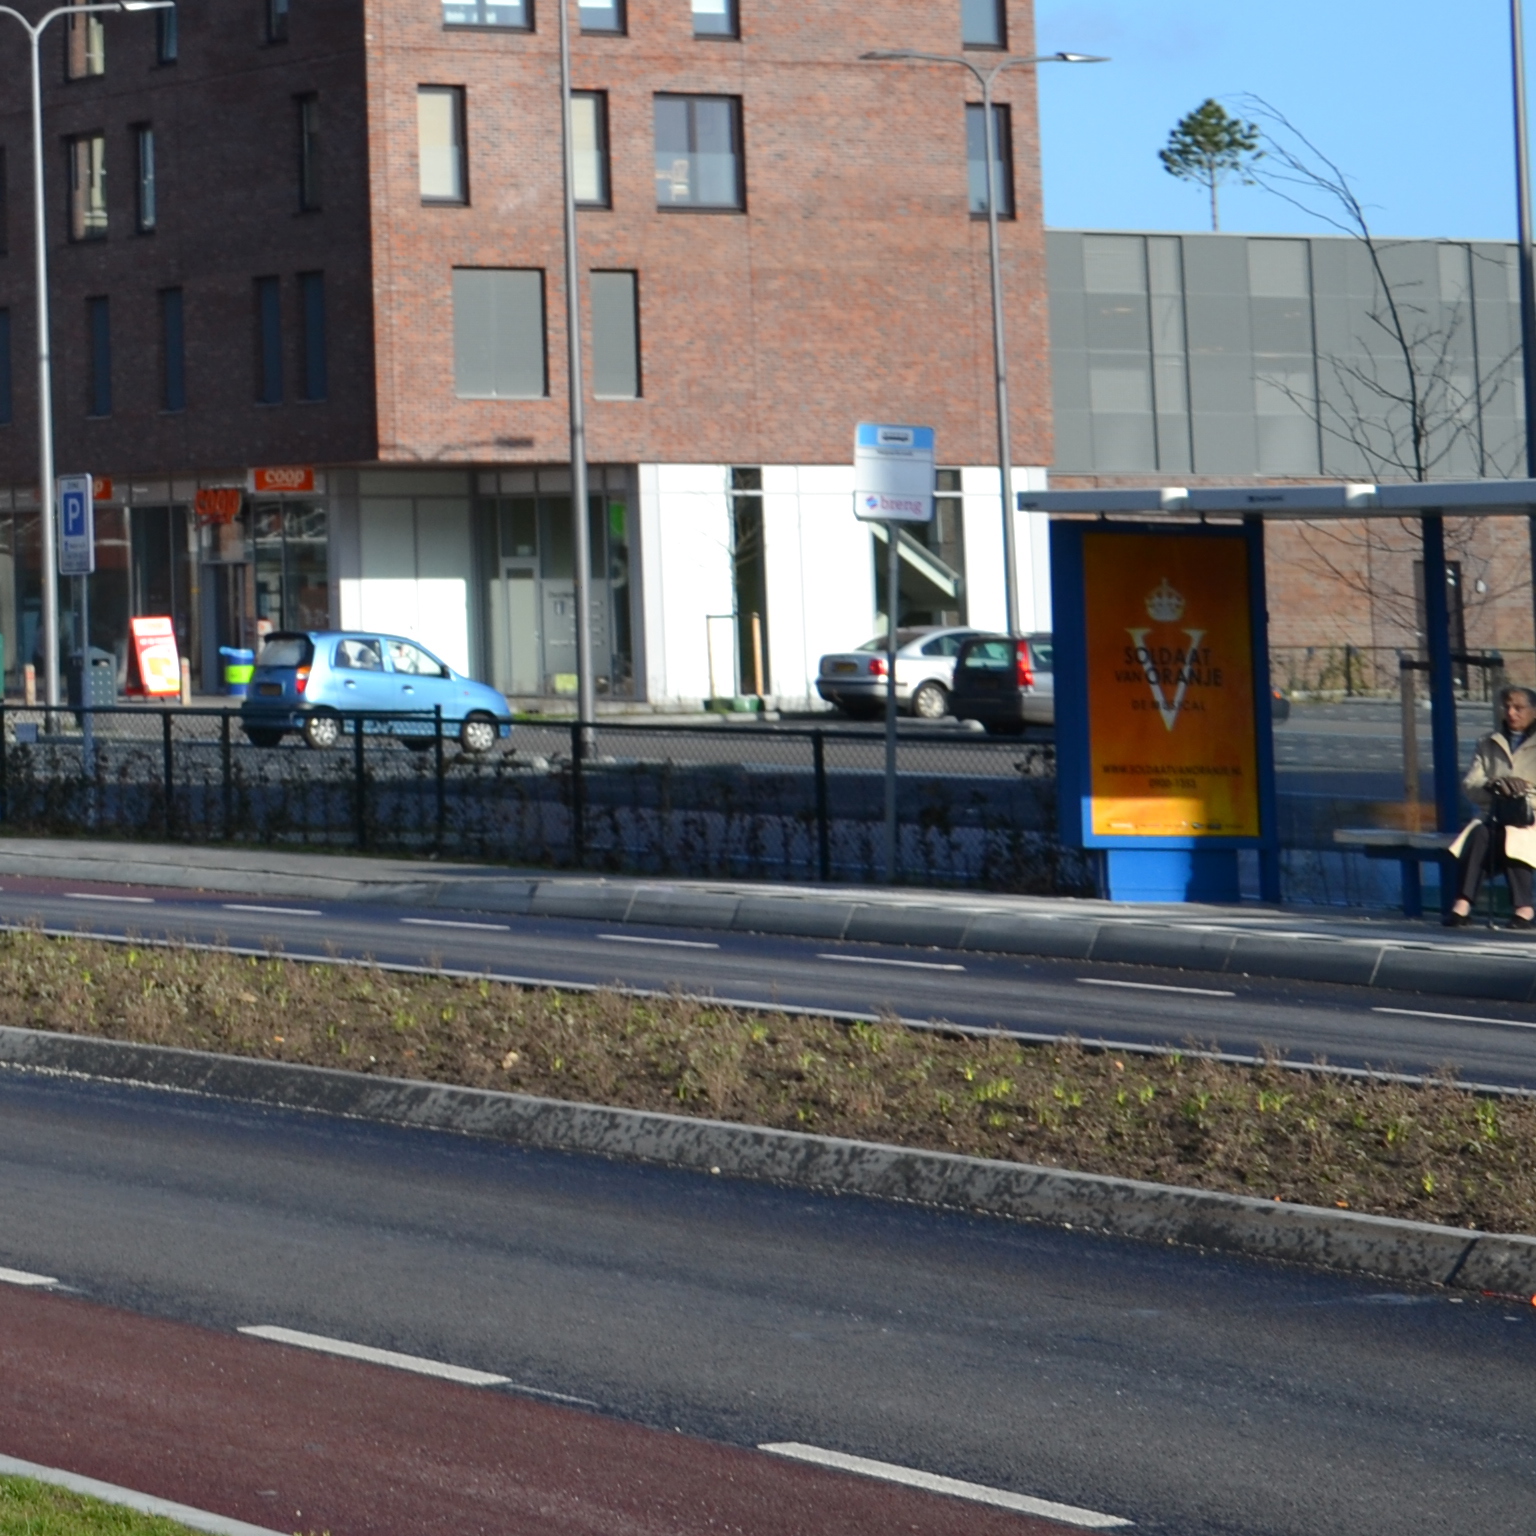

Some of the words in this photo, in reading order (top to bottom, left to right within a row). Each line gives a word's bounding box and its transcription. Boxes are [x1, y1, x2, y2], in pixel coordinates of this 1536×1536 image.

[264, 468, 305, 488] coop
[68, 498, 81, 532] P
[880, 495, 923, 516] breng
[1123, 645, 1212, 667] SOLDAAT
[1115, 670, 1142, 683] VAN
[1145, 666, 1223, 687] ORANJE
